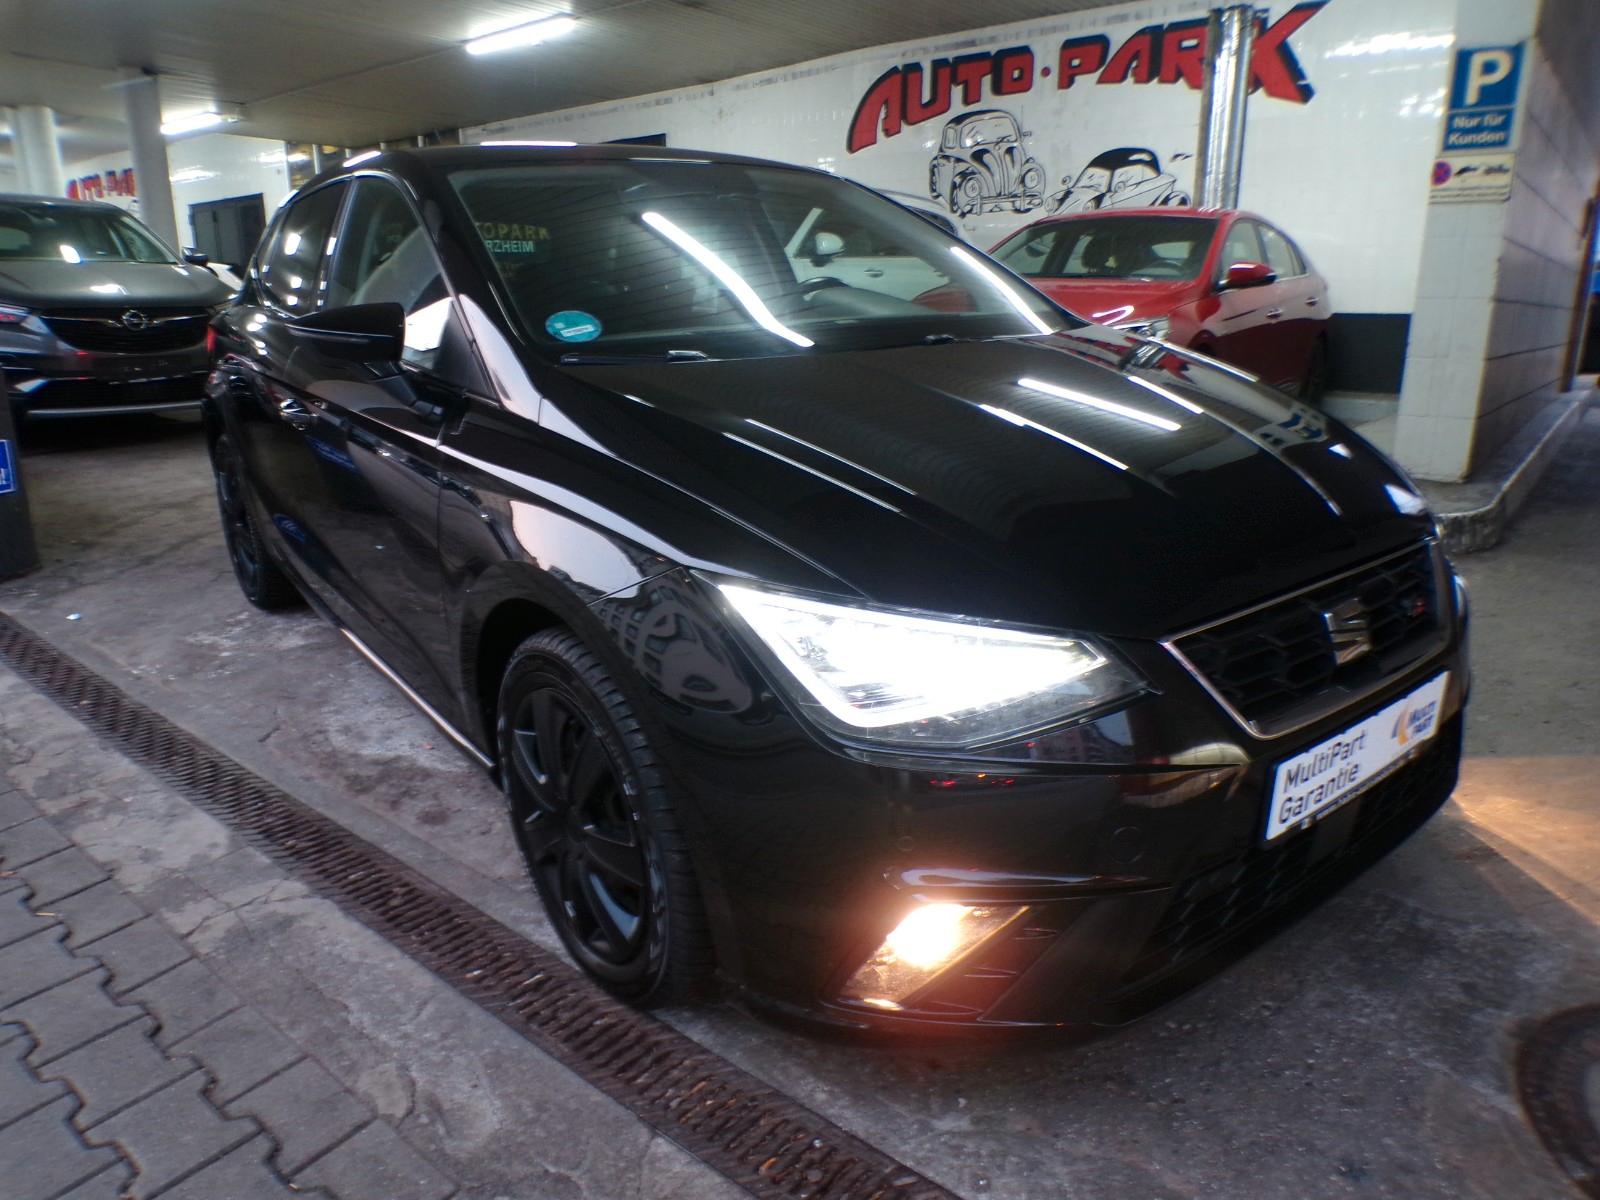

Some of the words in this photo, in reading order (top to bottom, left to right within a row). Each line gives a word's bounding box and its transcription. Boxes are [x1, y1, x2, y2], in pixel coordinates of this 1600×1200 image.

[847, 45, 1034, 153] AUTO
[1057, 0, 1332, 105] PARK
[1465, 51, 1513, 106] P
[1449, 131, 1505, 145] Kunden
[1454, 116, 1480, 129] Nur
[1484, 113, 1506, 126] für
[1283, 729, 1366, 794] MultiPart
[1278, 762, 1360, 825] Garantie
